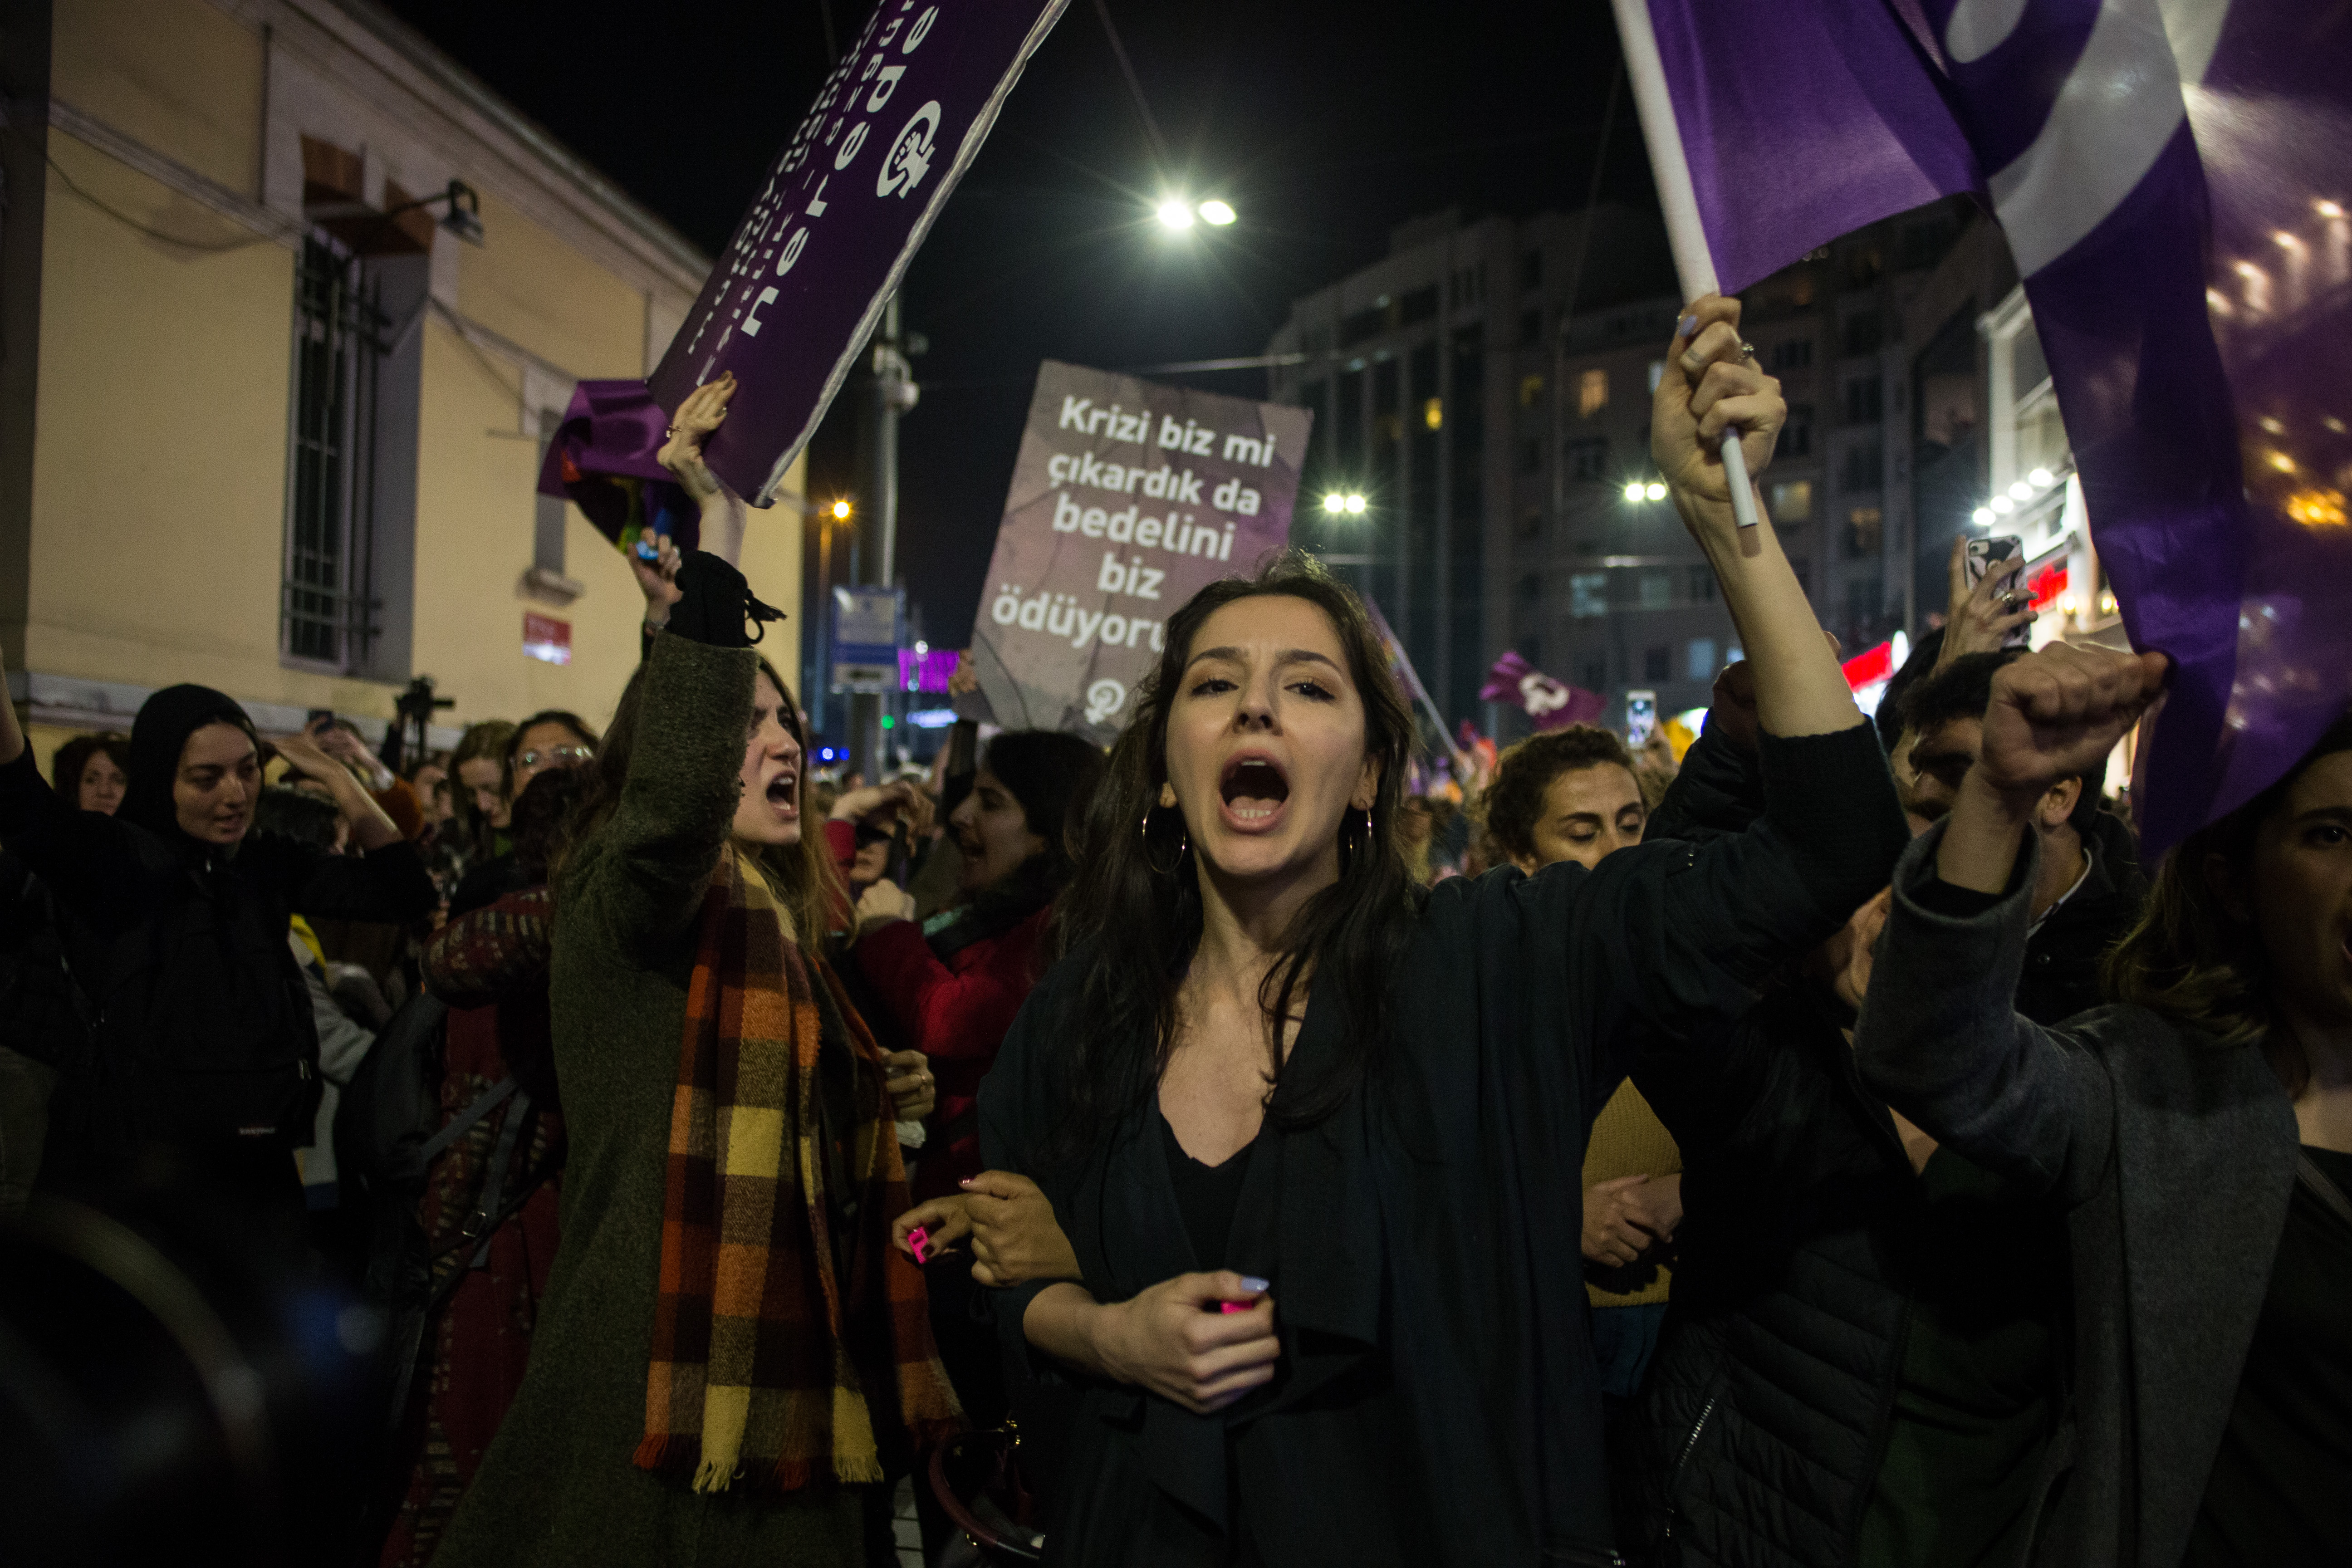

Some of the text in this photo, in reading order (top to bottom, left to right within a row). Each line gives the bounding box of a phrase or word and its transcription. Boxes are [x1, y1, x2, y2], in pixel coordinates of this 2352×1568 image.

[740, 5, 940, 337] nerede
[1057, 395, 1276, 468] Krizi biz mi
[1048, 451, 1261, 517] çıkardık da
[1052, 492, 1237, 562] bedelini
[1097, 552, 1166, 600] biz
